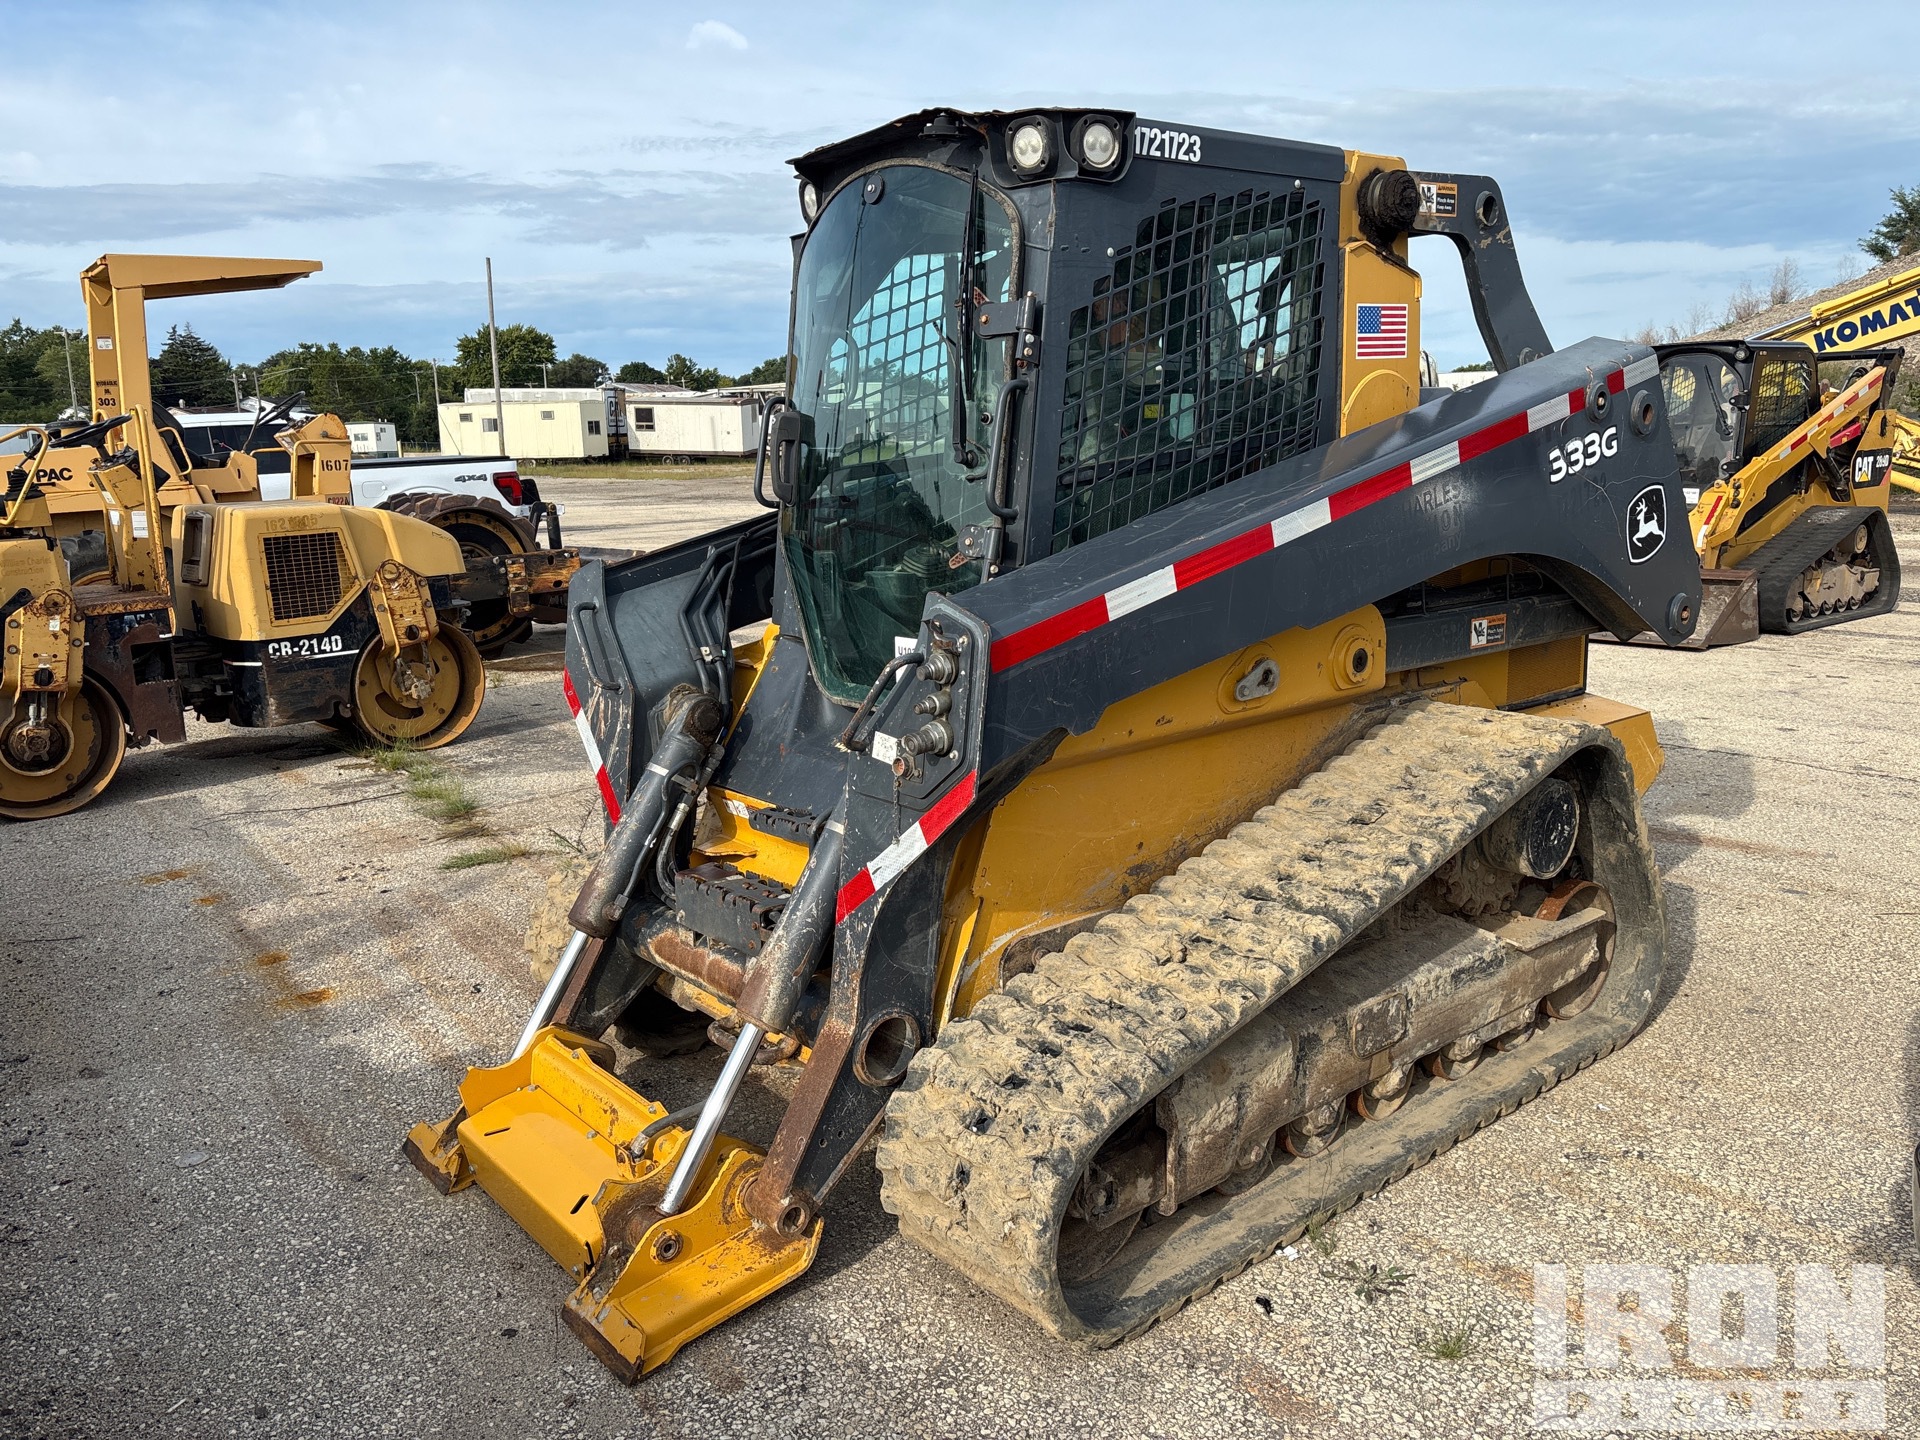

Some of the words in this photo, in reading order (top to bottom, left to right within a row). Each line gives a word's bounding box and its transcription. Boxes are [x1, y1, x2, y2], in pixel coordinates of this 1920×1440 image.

[1134, 126, 1201, 162] 1721723
[98, 397, 116, 407] 303
[321, 459, 349, 471] 1607
[1549, 426, 1618, 483] 333G
[1855, 456, 1874, 482] CAT
